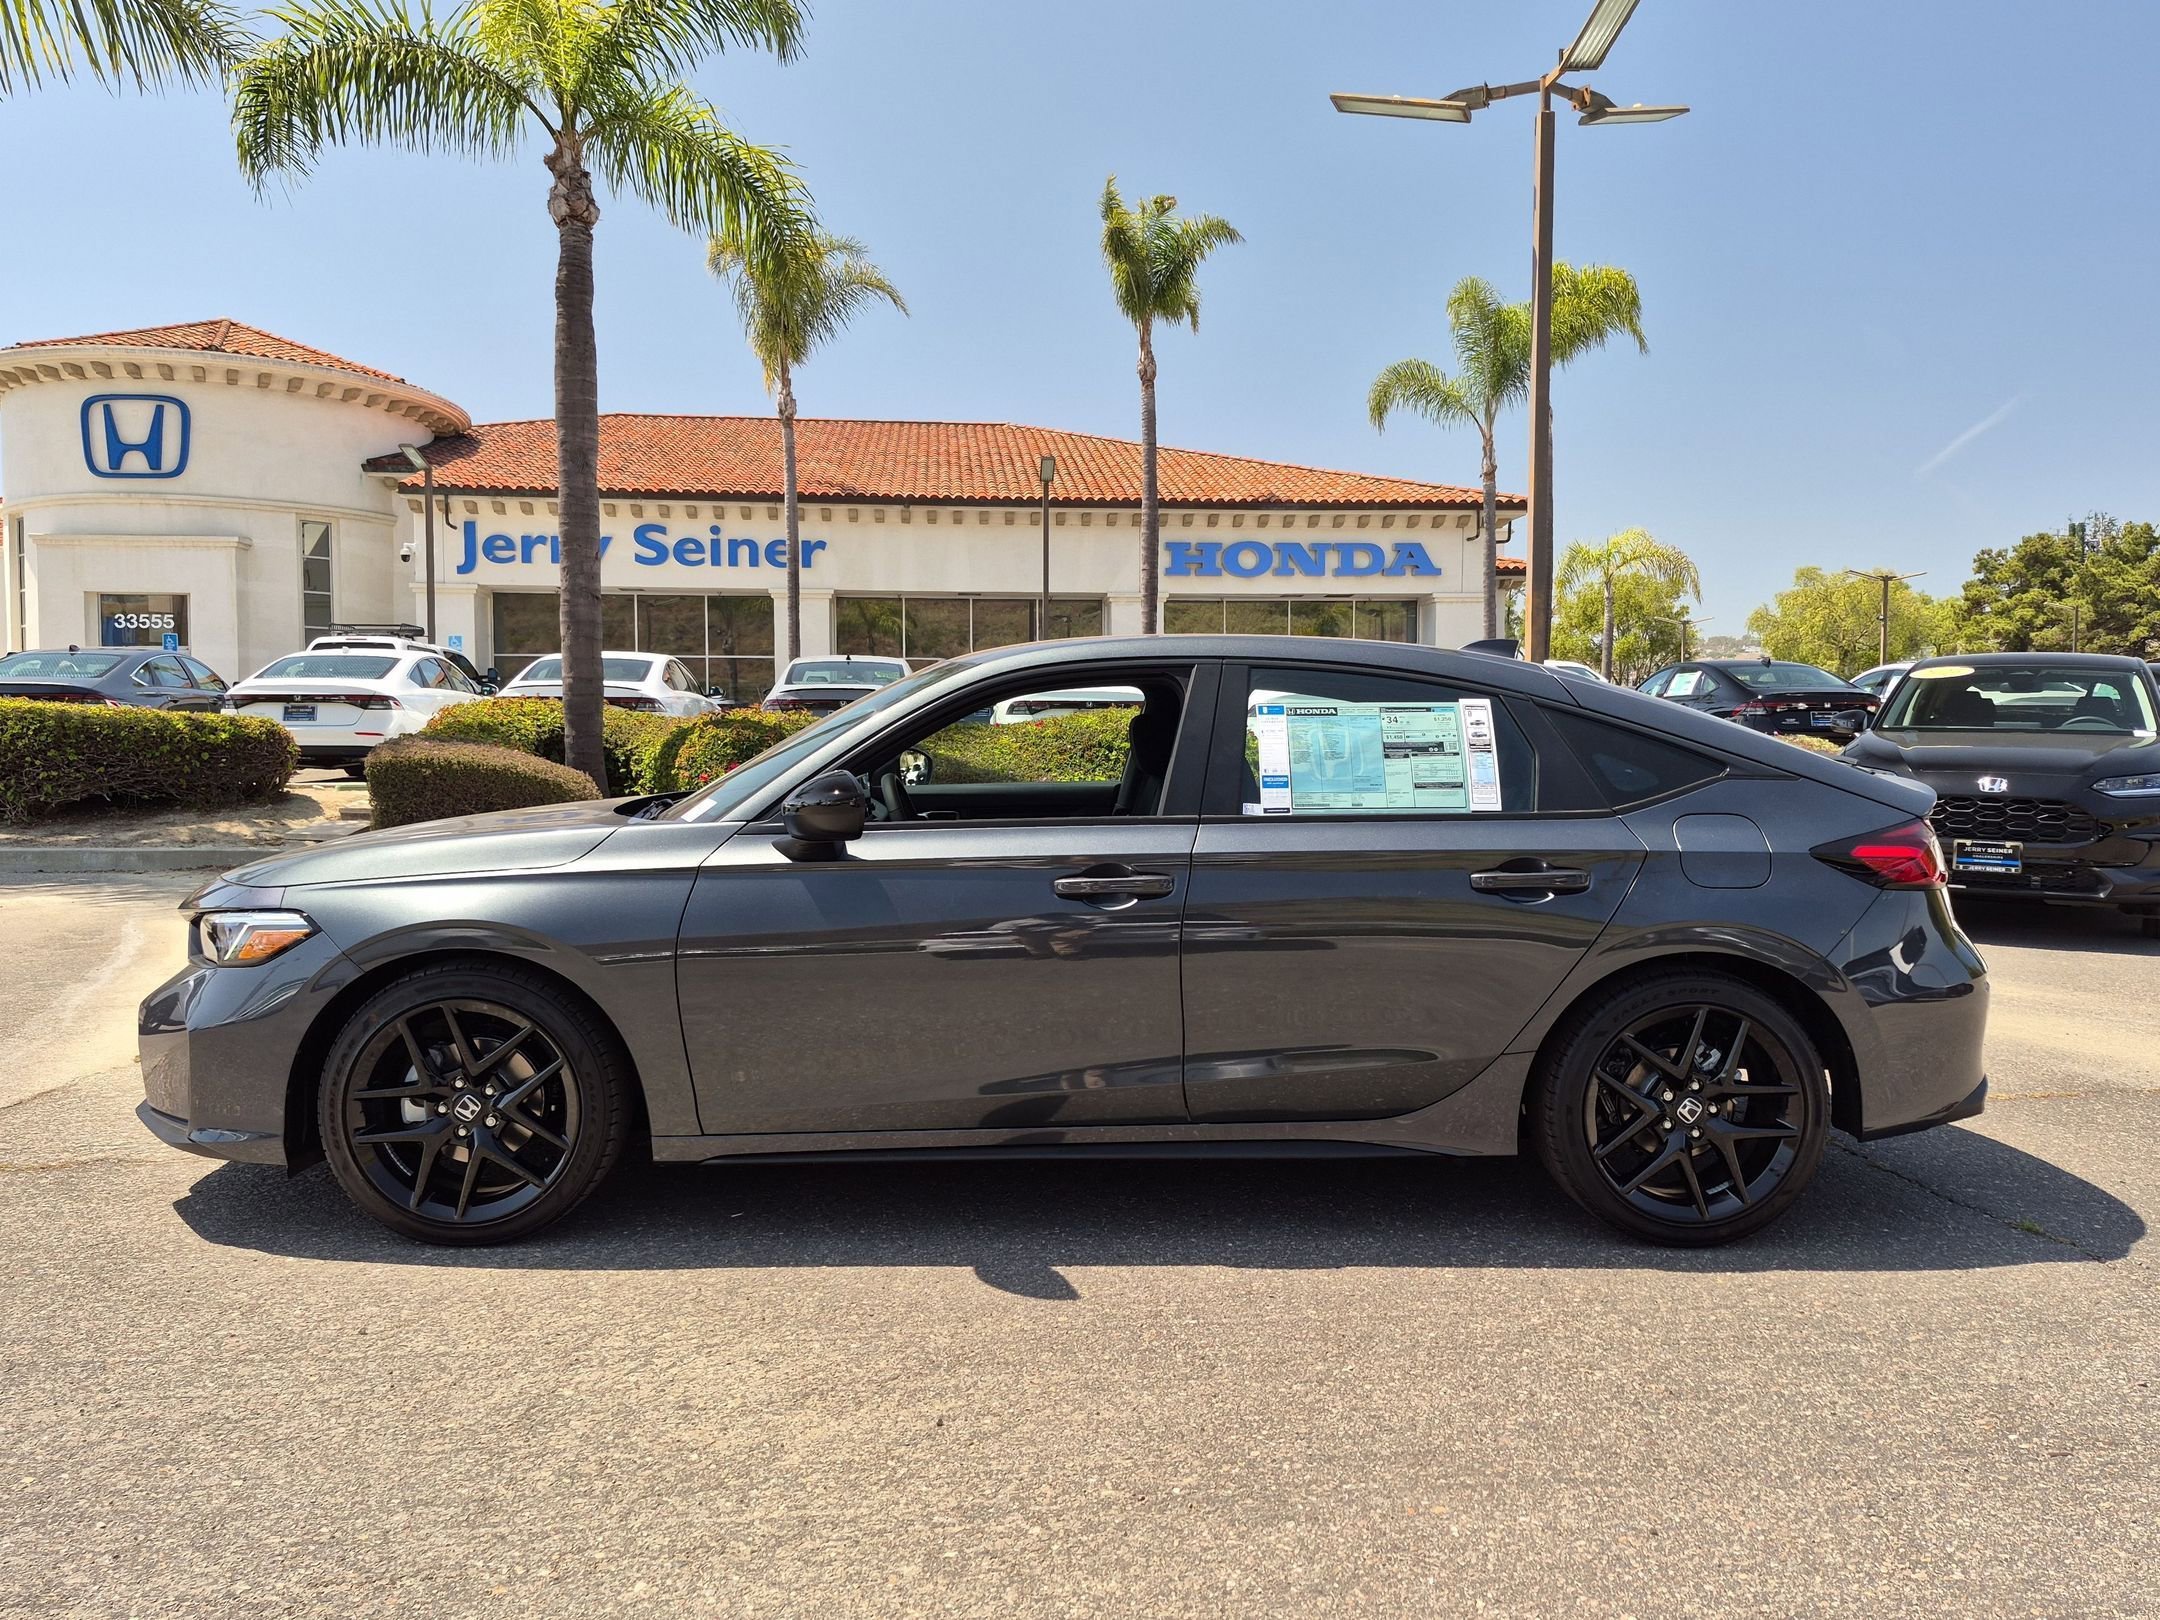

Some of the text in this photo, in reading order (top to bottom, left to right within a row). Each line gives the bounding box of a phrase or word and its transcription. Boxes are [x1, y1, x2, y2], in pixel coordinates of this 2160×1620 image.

[633, 523, 828, 569] Seiner
[1164, 540, 1442, 577] HONDA
[114, 613, 175, 629] 33555
[1386, 716, 1398, 724] 34
